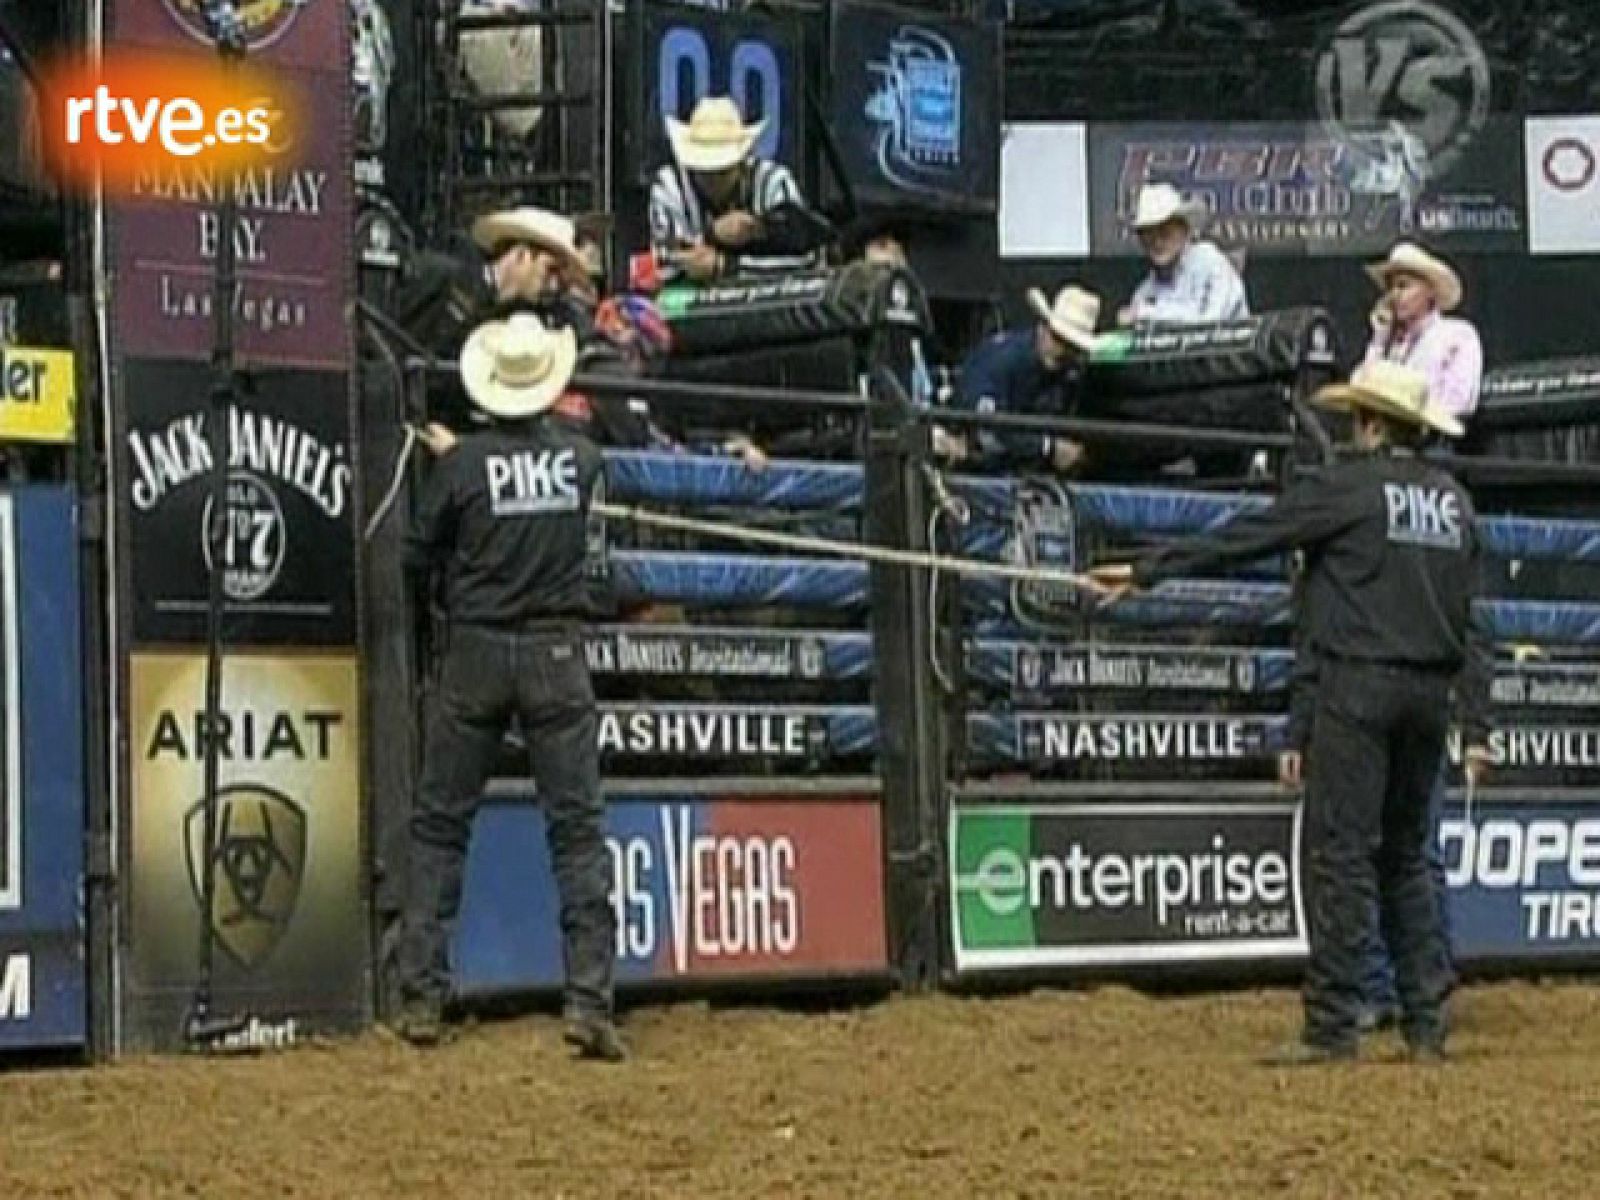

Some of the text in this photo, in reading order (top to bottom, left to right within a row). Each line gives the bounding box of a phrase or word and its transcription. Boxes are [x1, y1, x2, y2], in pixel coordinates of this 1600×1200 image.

[0, 355, 48, 406] er
[128, 412, 214, 512] JACK
[486, 448, 578, 501] PIKE
[1383, 483, 1462, 537] PIKE
[146, 710, 343, 760] ARIAT
[597, 712, 804, 756] ASHVILLE
[1044, 721, 1245, 758] NASHVILLE
[1446, 729, 1600, 766] NSHVILL
[976, 833, 1289, 926] enterprise
[1439, 820, 1600, 888] OOPE
[604, 804, 798, 975] AS VEGAS
[1183, 909, 1291, 935] rent-a-car
[1519, 891, 1600, 941] TIR
